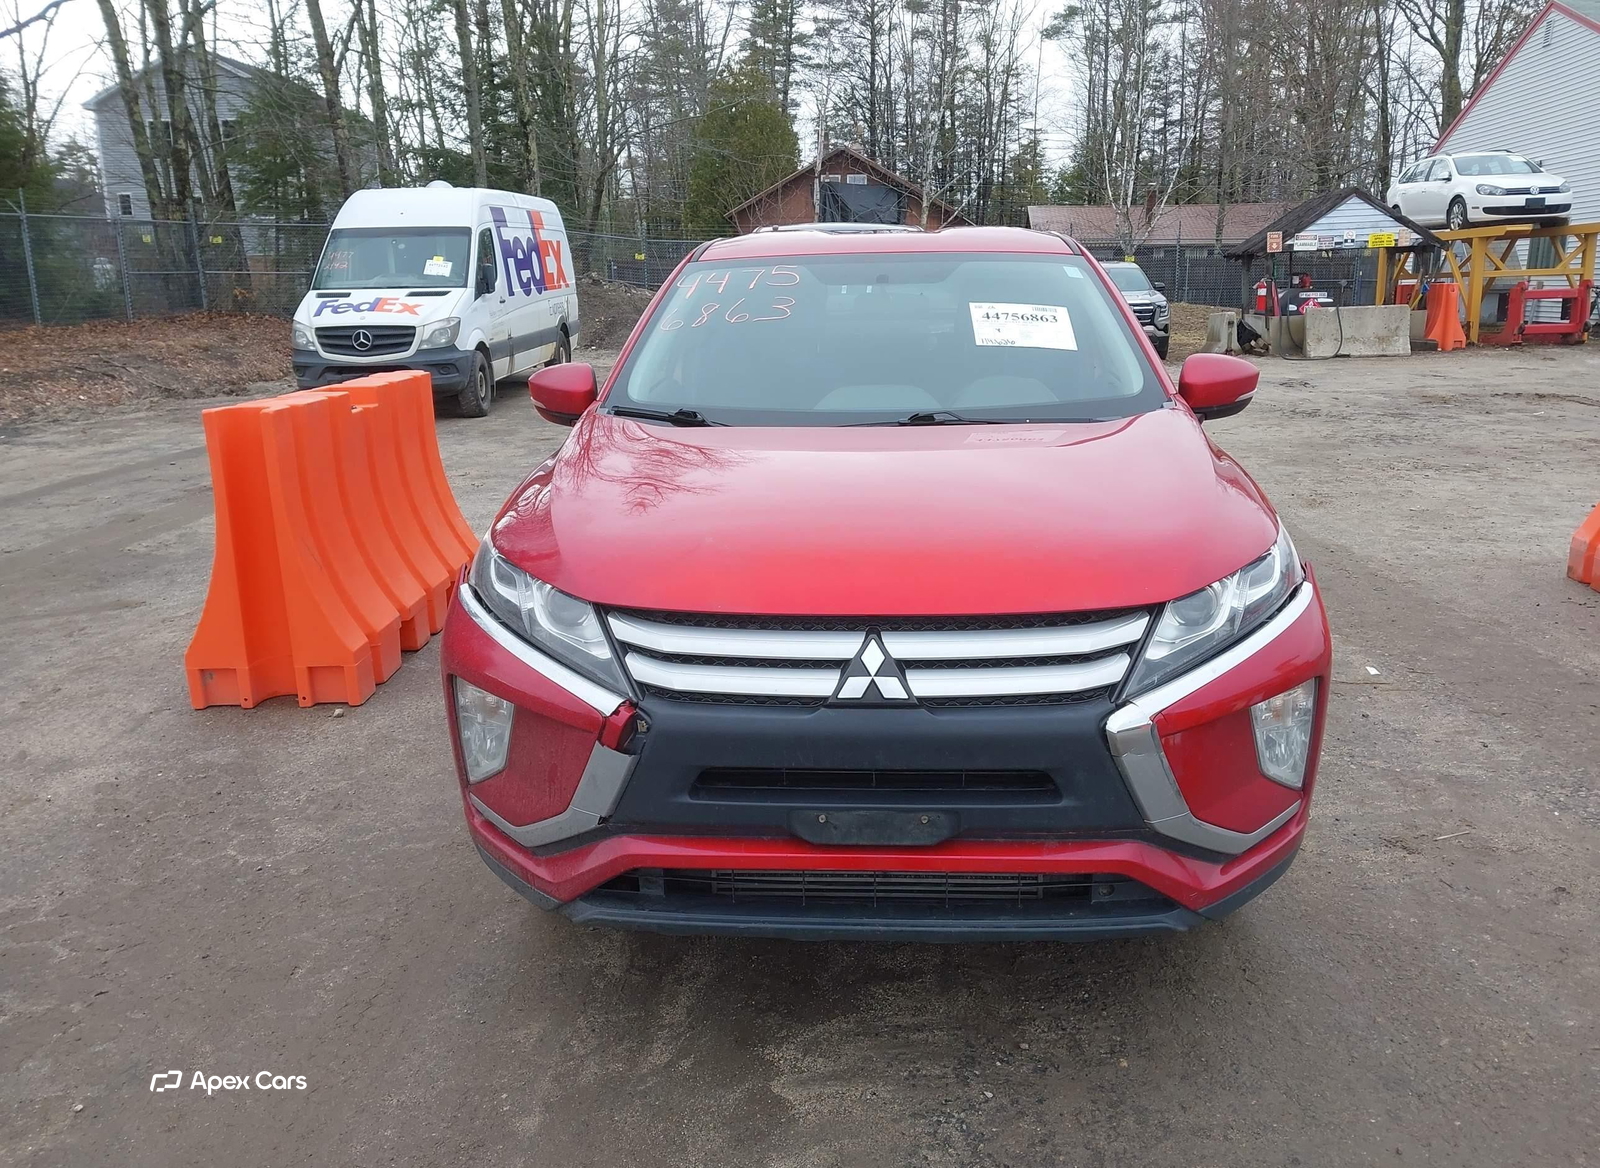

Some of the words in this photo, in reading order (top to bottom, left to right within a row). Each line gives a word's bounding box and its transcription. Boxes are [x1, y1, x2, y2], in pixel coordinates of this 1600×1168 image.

[489, 206, 570, 297] FedEx
[677, 265, 800, 299] 4475
[313, 297, 425, 318] FedEx
[660, 297, 796, 331] 6863
[981, 312, 1059, 324] 44756863
